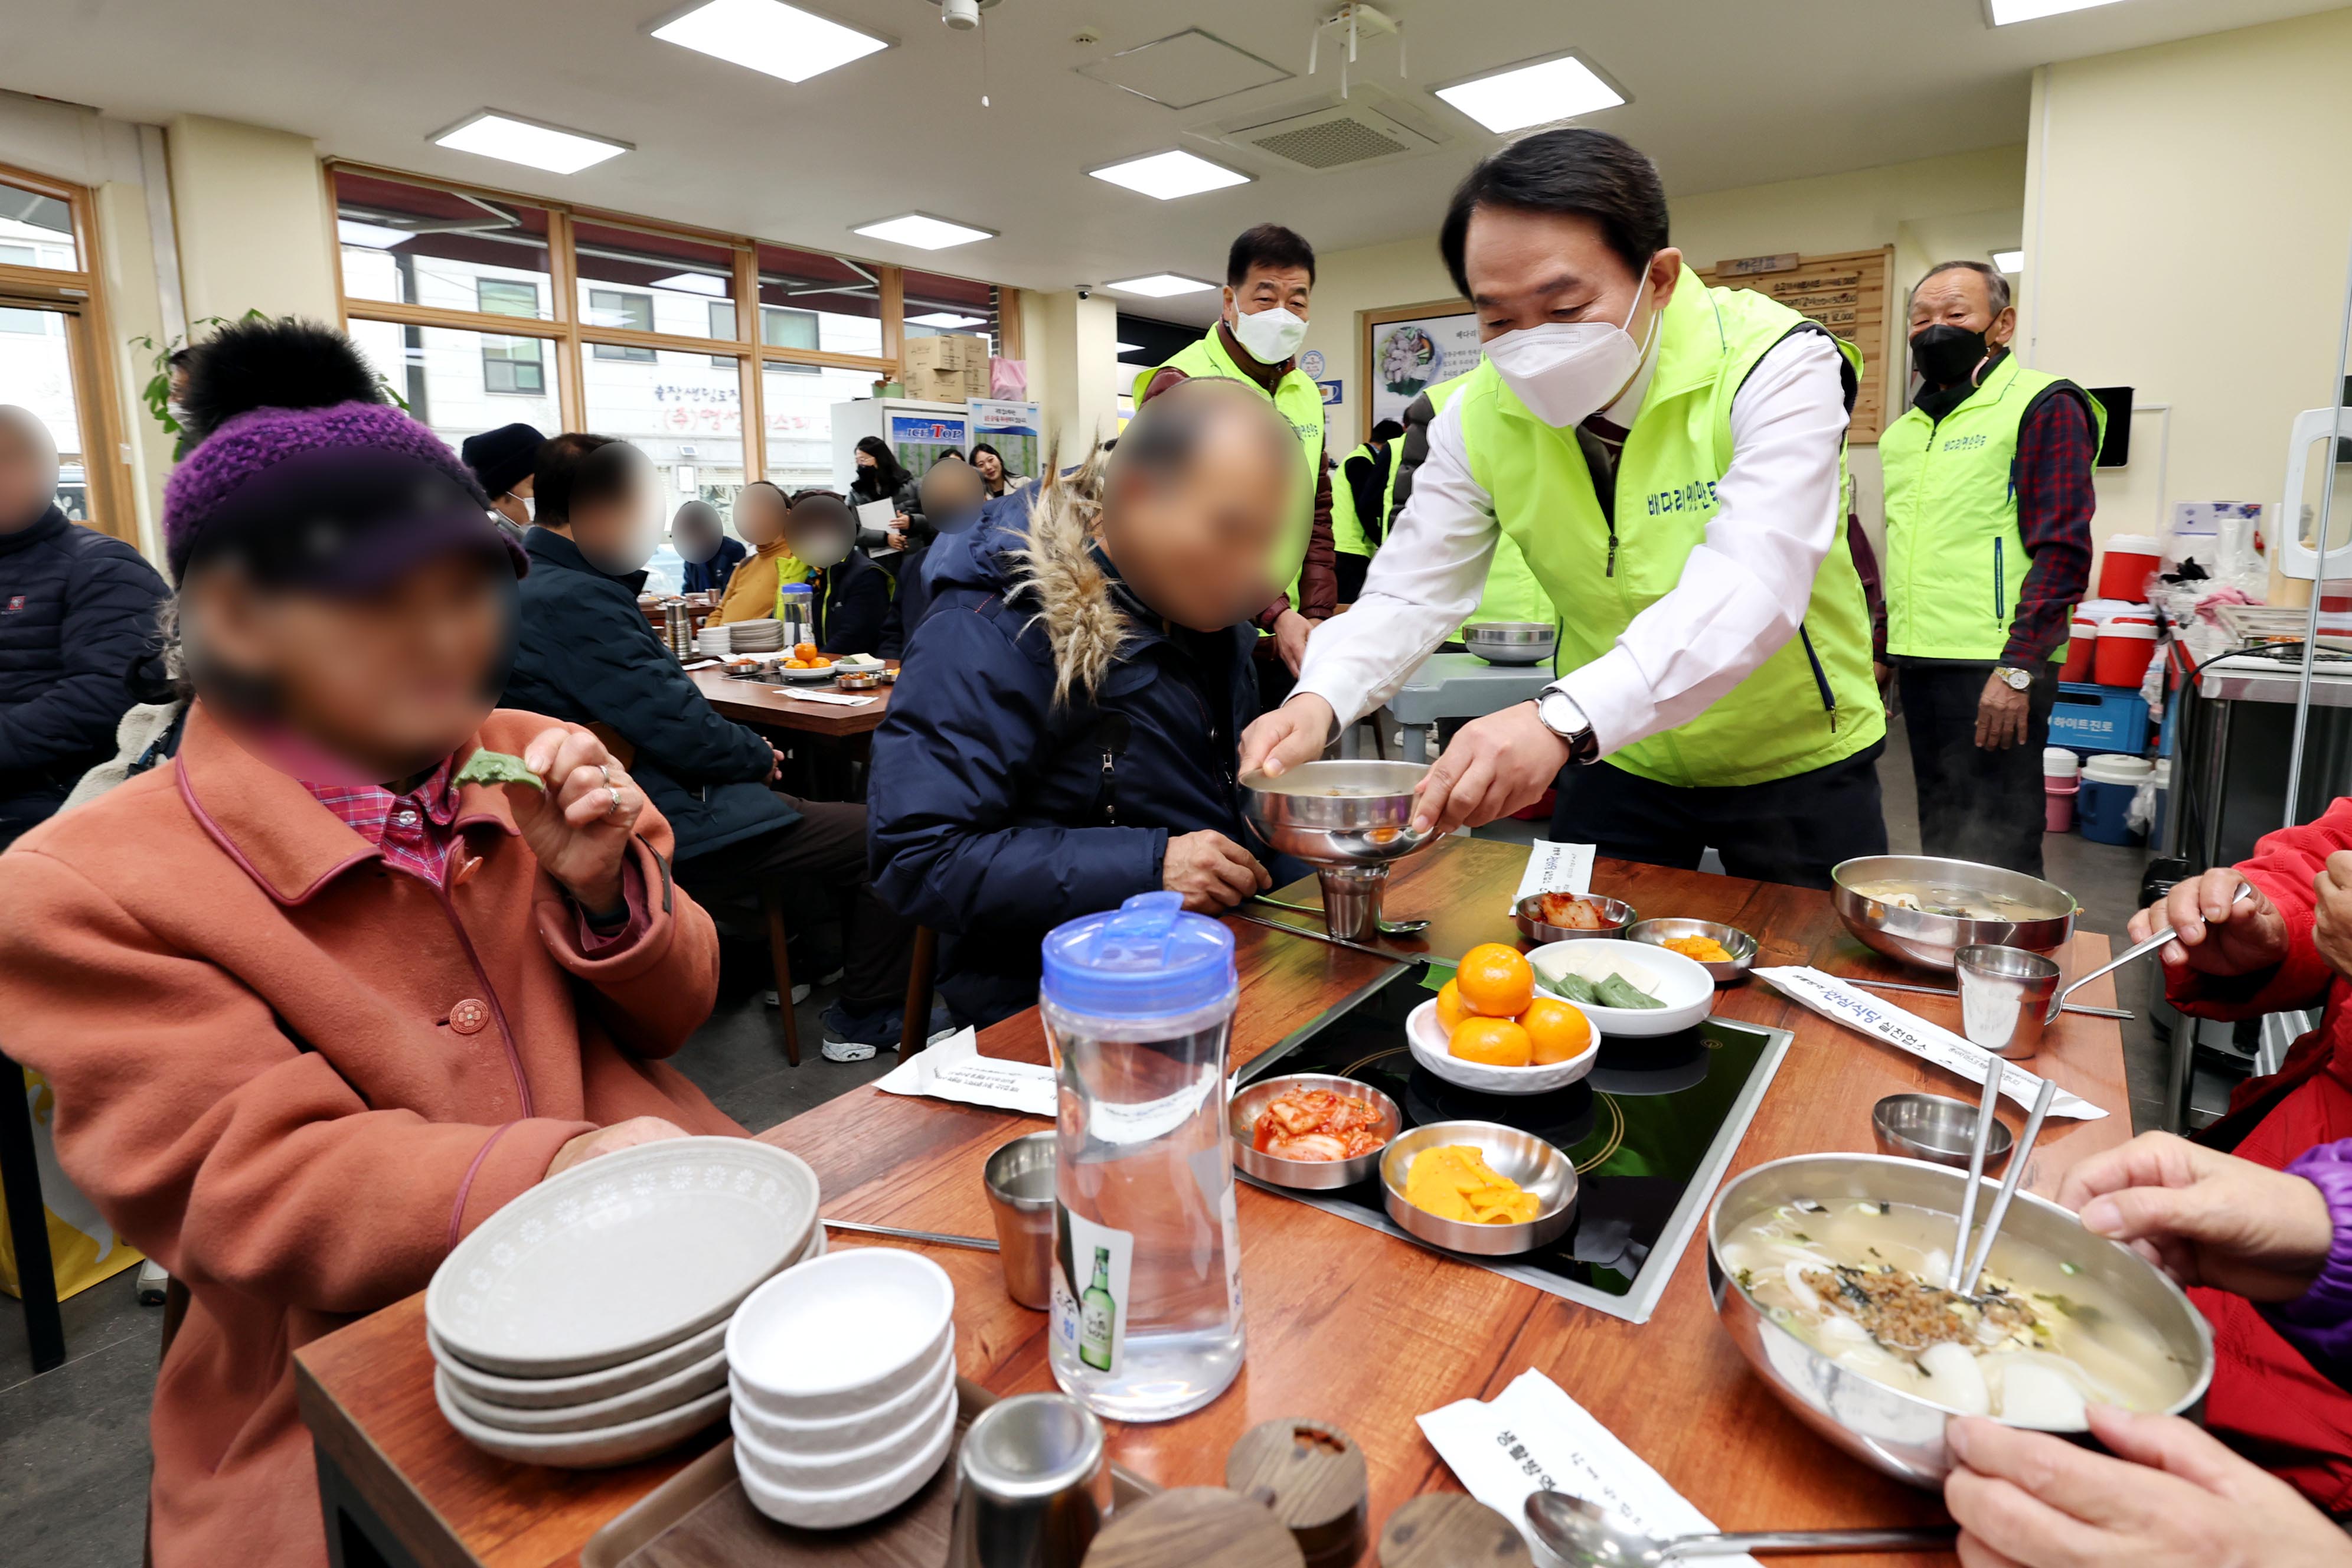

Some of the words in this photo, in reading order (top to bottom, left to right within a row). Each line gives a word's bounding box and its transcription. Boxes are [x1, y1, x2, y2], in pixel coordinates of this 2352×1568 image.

[907, 428, 929, 438] ICE
[931, 424, 965, 440] TOP
[2054, 717, 2114, 732] 하이트진로
[1821, 989, 1883, 1024] 안심식당
[1878, 1021, 1928, 1051] 실천업소
[1497, 1430, 1557, 1492] 생활방역
